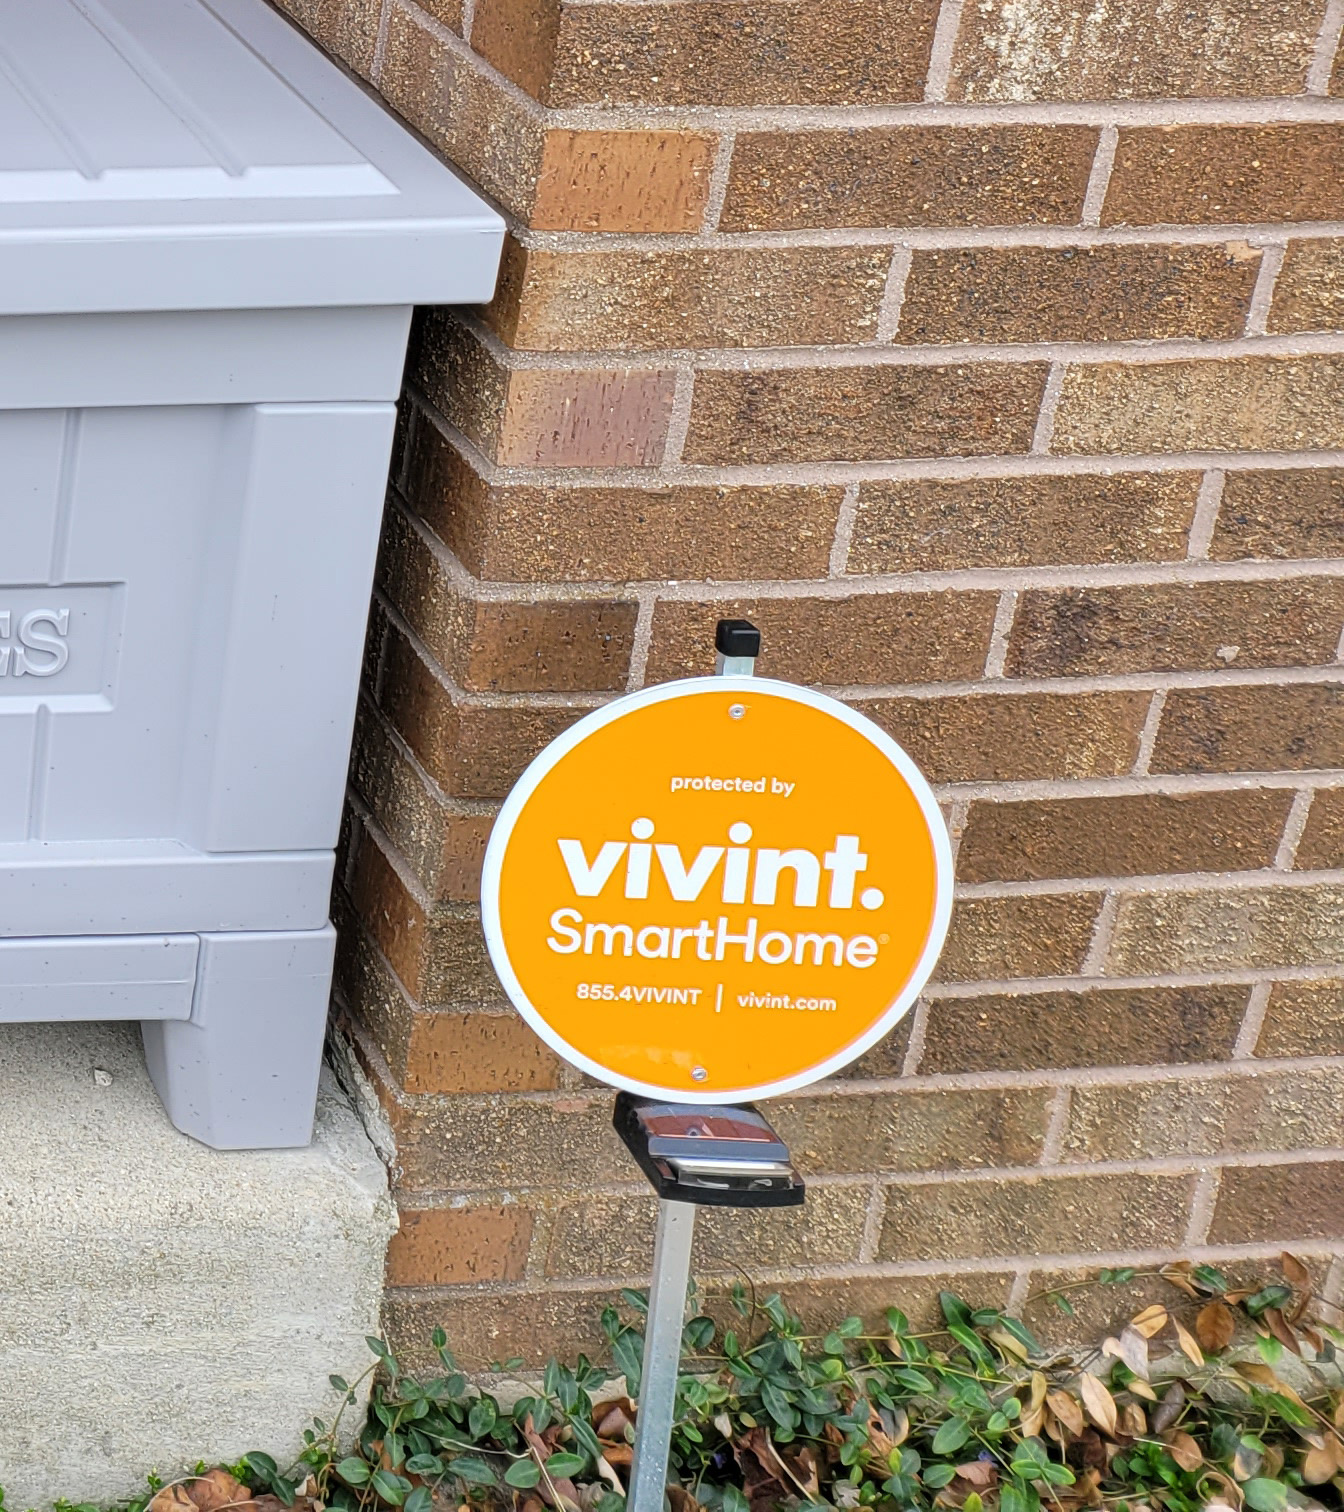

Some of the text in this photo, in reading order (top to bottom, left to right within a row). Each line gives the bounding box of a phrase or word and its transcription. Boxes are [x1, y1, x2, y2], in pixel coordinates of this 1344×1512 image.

[670, 775, 796, 798] protected by
[556, 816, 886, 911] vivint.
[545, 907, 880, 969] SmartHome
[575, 983, 838, 1012] 855.4VIVINT vivint.com
